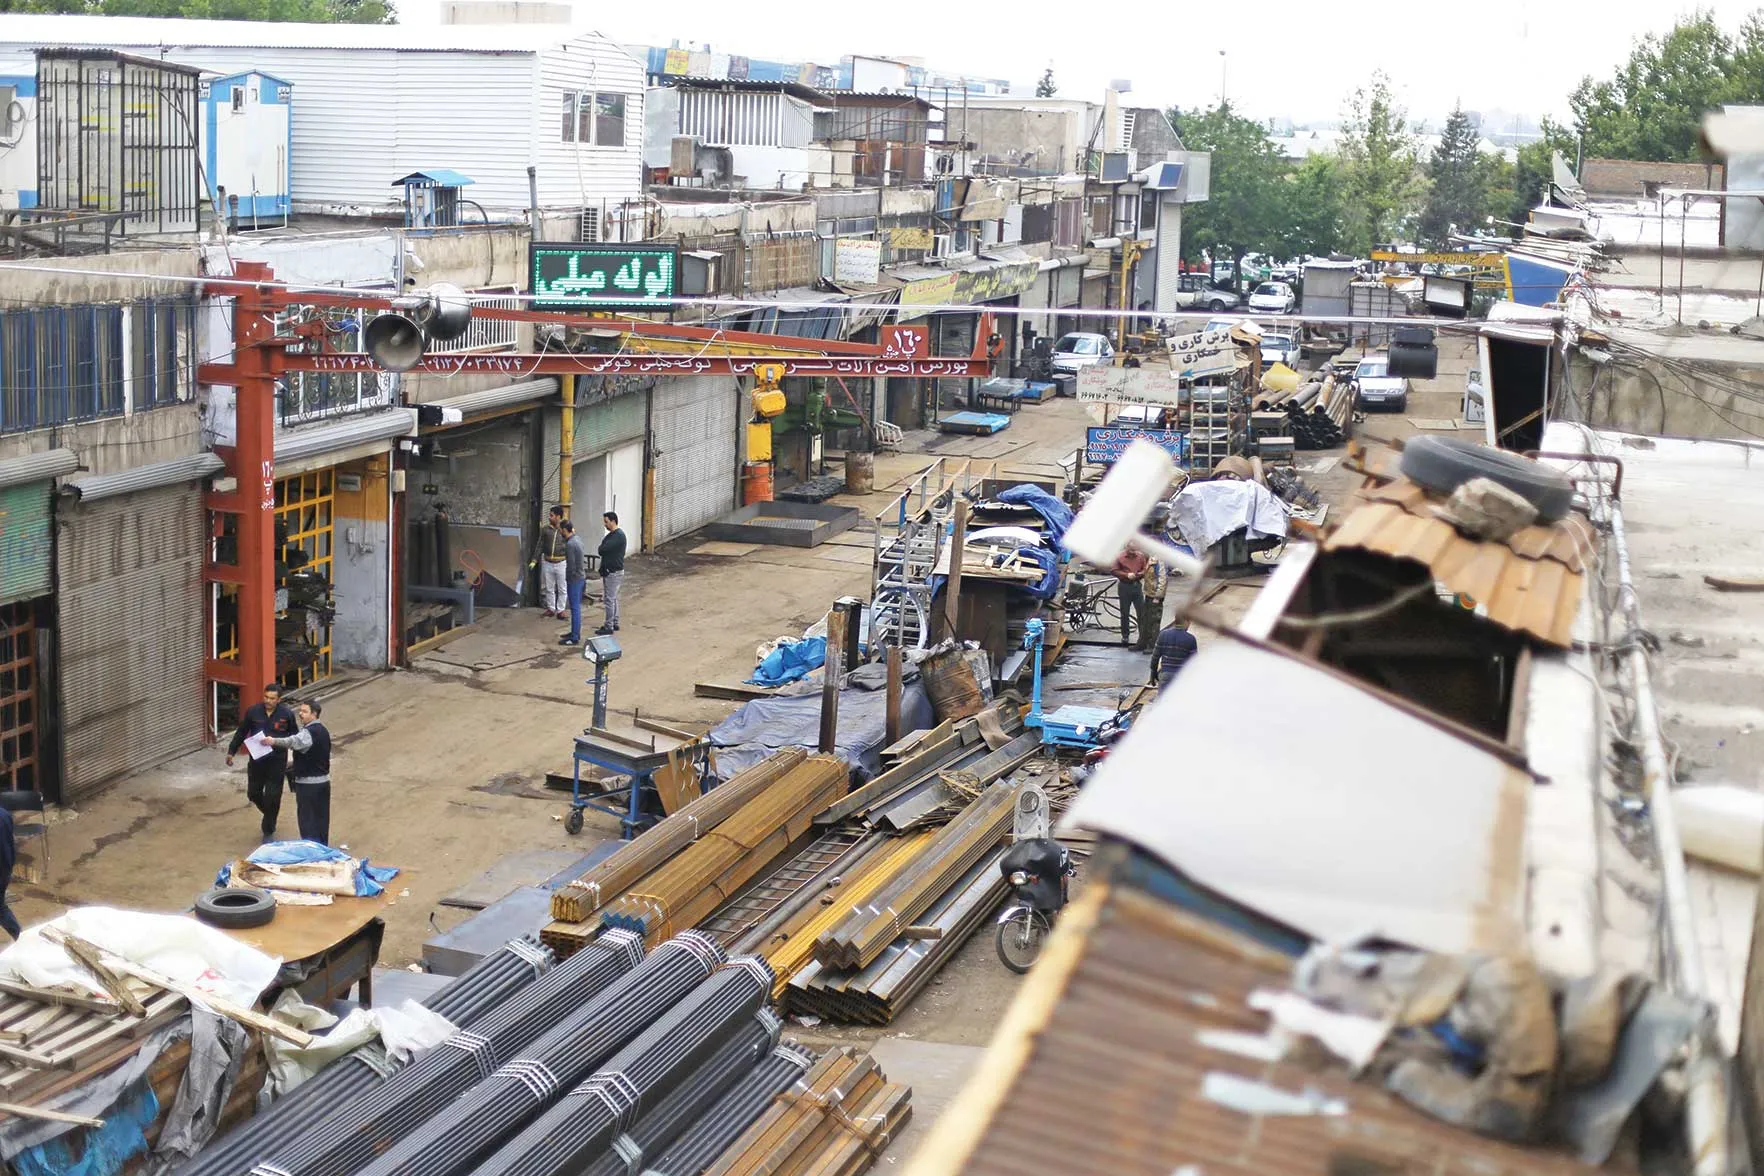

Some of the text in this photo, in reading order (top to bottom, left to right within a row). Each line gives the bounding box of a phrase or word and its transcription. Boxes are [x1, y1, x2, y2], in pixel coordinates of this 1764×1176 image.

[613, 254, 669, 299] لوله
[1170, 331, 1229, 352] برش کاری و
[837, 360, 875, 374] آلات
[920, 361, 968, 375] بورس
[1155, 428, 1181, 448] برش
